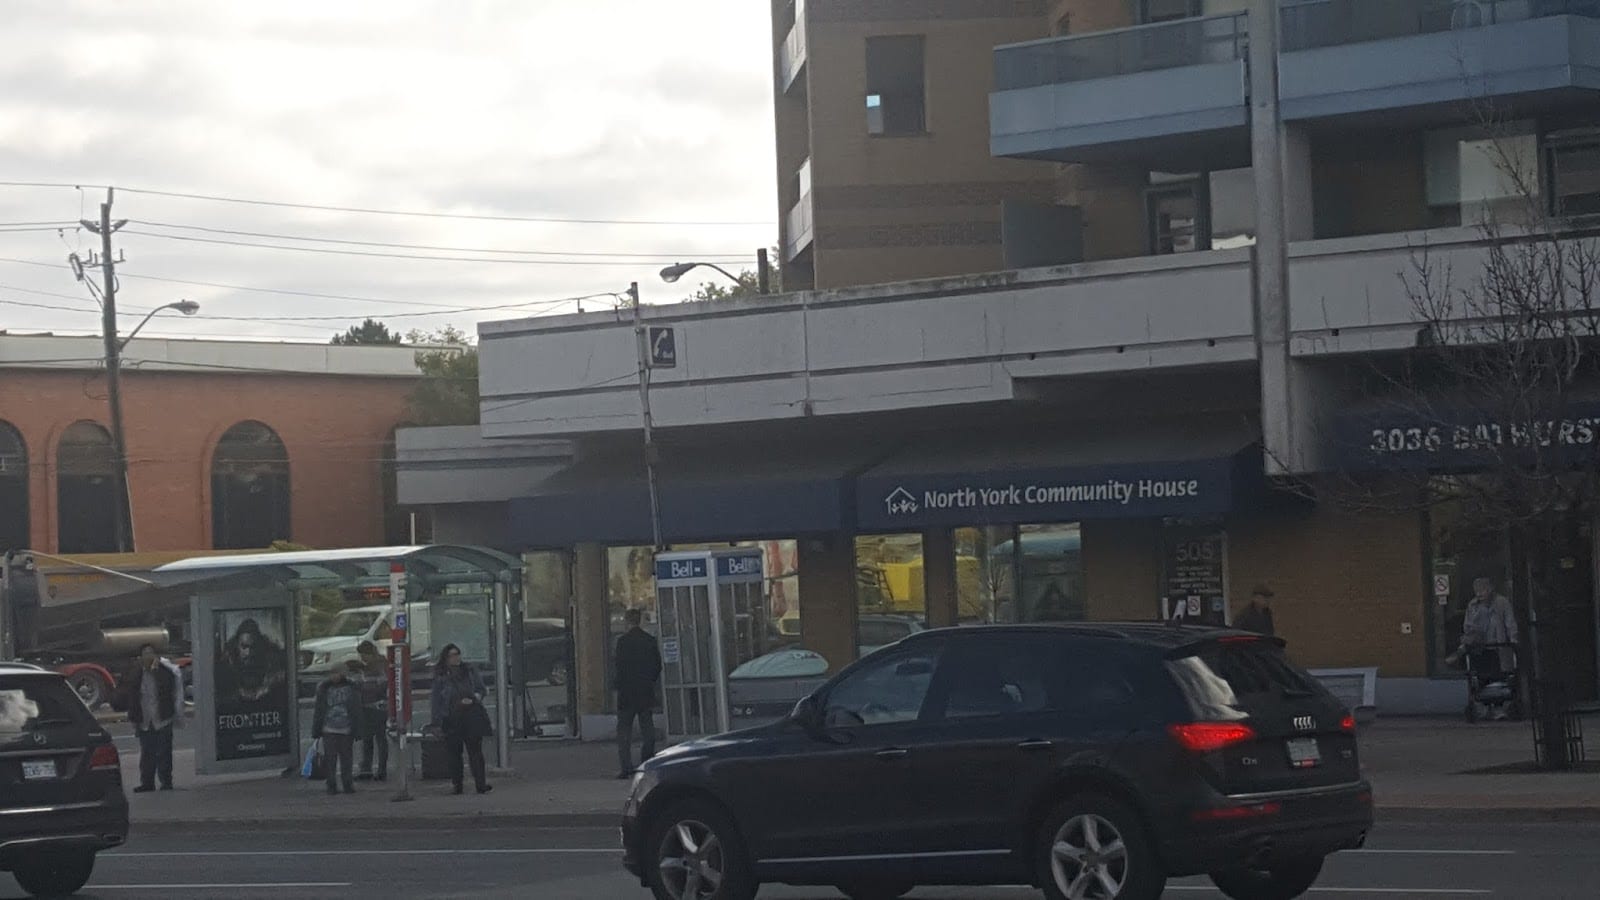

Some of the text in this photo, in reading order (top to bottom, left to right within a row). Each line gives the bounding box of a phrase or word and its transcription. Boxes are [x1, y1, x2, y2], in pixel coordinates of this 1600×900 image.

[1370, 427, 1441, 452] 3036
[924, 478, 1198, 509] North York Community House
[1175, 542, 1213, 562] 505
[671, 561, 693, 577] Bell
[728, 558, 748, 574] Bell
[218, 712, 281, 730] FRONTIER
